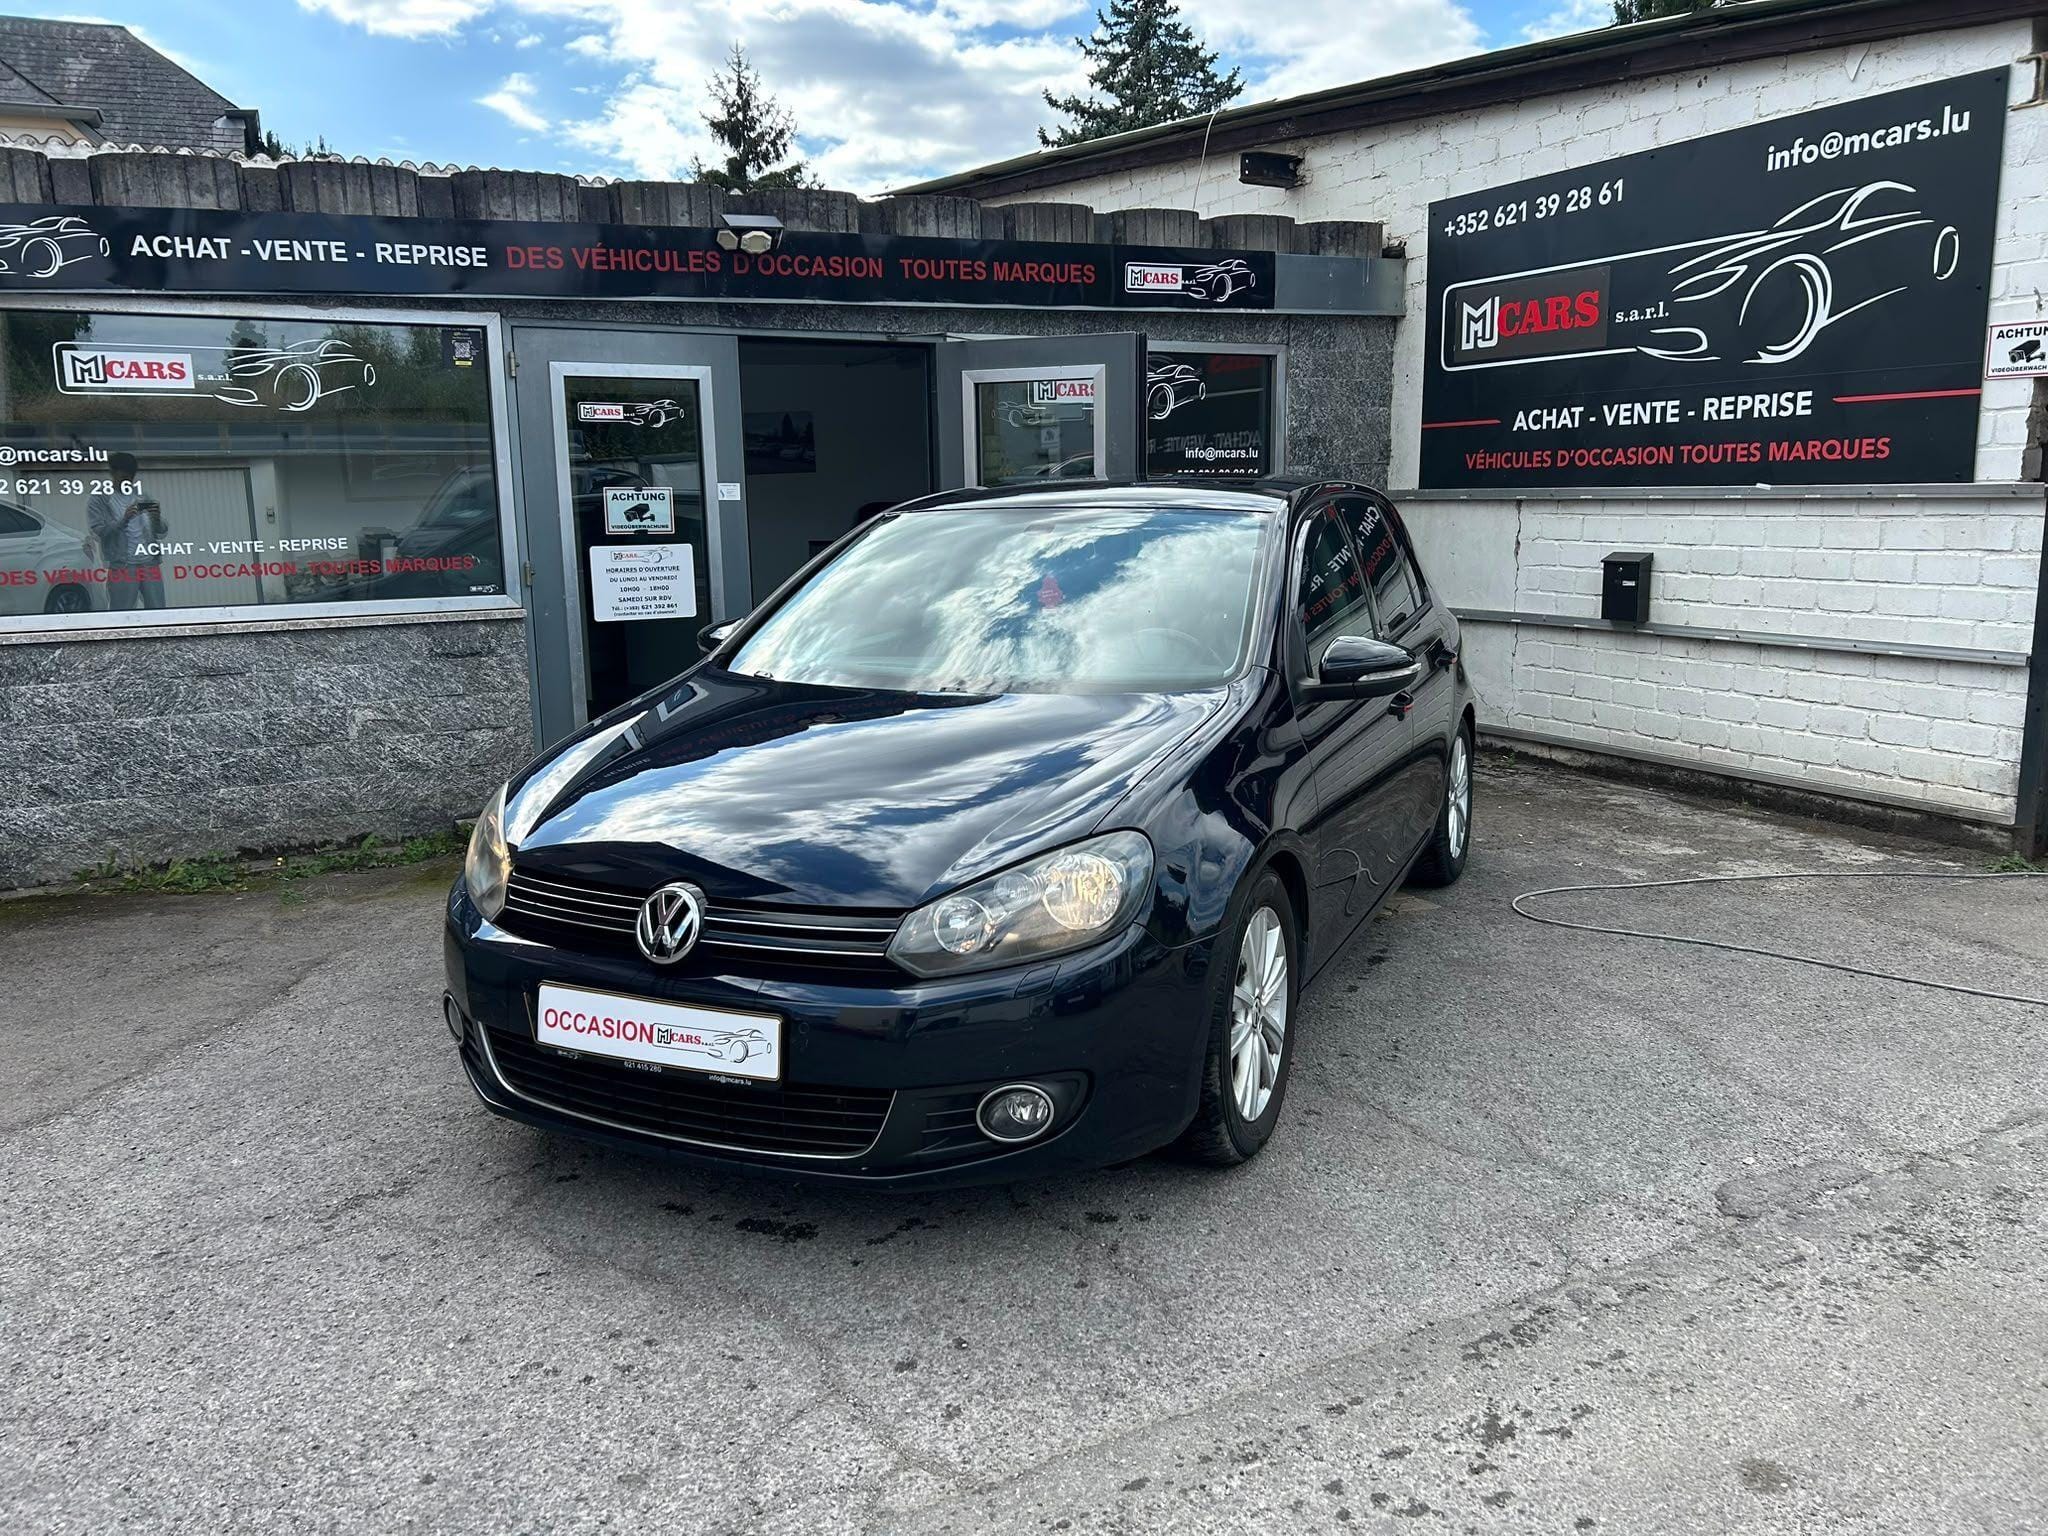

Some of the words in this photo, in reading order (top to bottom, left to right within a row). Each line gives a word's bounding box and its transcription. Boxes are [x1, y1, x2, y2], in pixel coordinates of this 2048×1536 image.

[1767, 105, 1970, 171] info@mcars.lu
[1444, 209, 1488, 237] +352
[1494, 200, 1527, 227] 621
[1535, 193, 1560, 219] 39
[1566, 186, 1592, 212] 28
[1599, 178, 1623, 205] 61
[130, 234, 231, 259] ACHAT
[375, 242, 488, 267] REPRISE
[506, 245, 564, 269] DES
[571, 242, 721, 272] VÉHICULES
[733, 254, 882, 278] D'OCCASION
[900, 258, 987, 281] TOUTES
[993, 261, 1095, 284] MARQUES
[1615, 301, 1669, 322] s.a.r.l.
[1512, 406, 1584, 431] ACHAT
[1602, 400, 1680, 426] VENTE
[1703, 390, 1813, 421] REPRISE
[1185, 447, 1258, 461] info@mcars.lu
[1466, 449, 1551, 469] VÉHICULES
[1557, 446, 1674, 467] D'OCCASION
[1680, 442, 1762, 464] TOUTES
[1768, 437, 1891, 461] MARQUES
[15, 479, 51, 495] 621
[59, 479, 84, 495] 39
[90, 480, 115, 495] 28
[120, 480, 143, 495] 61
[611, 492, 666, 501] ACHTUNG
[135, 542, 194, 556] ACHAT
[208, 540, 264, 554] VENTE
[279, 537, 348, 552] REPRISE
[43, 565, 162, 584] VÉHICULES
[174, 560, 296, 579] D'OCCASION
[308, 560, 381, 575] TOUTES
[386, 556, 474, 572] MARQUES
[544, 1008, 653, 1044] OCCASION
[624, 1061, 635, 1069] 621
[709, 1075, 752, 1086] info@mcars.lu
